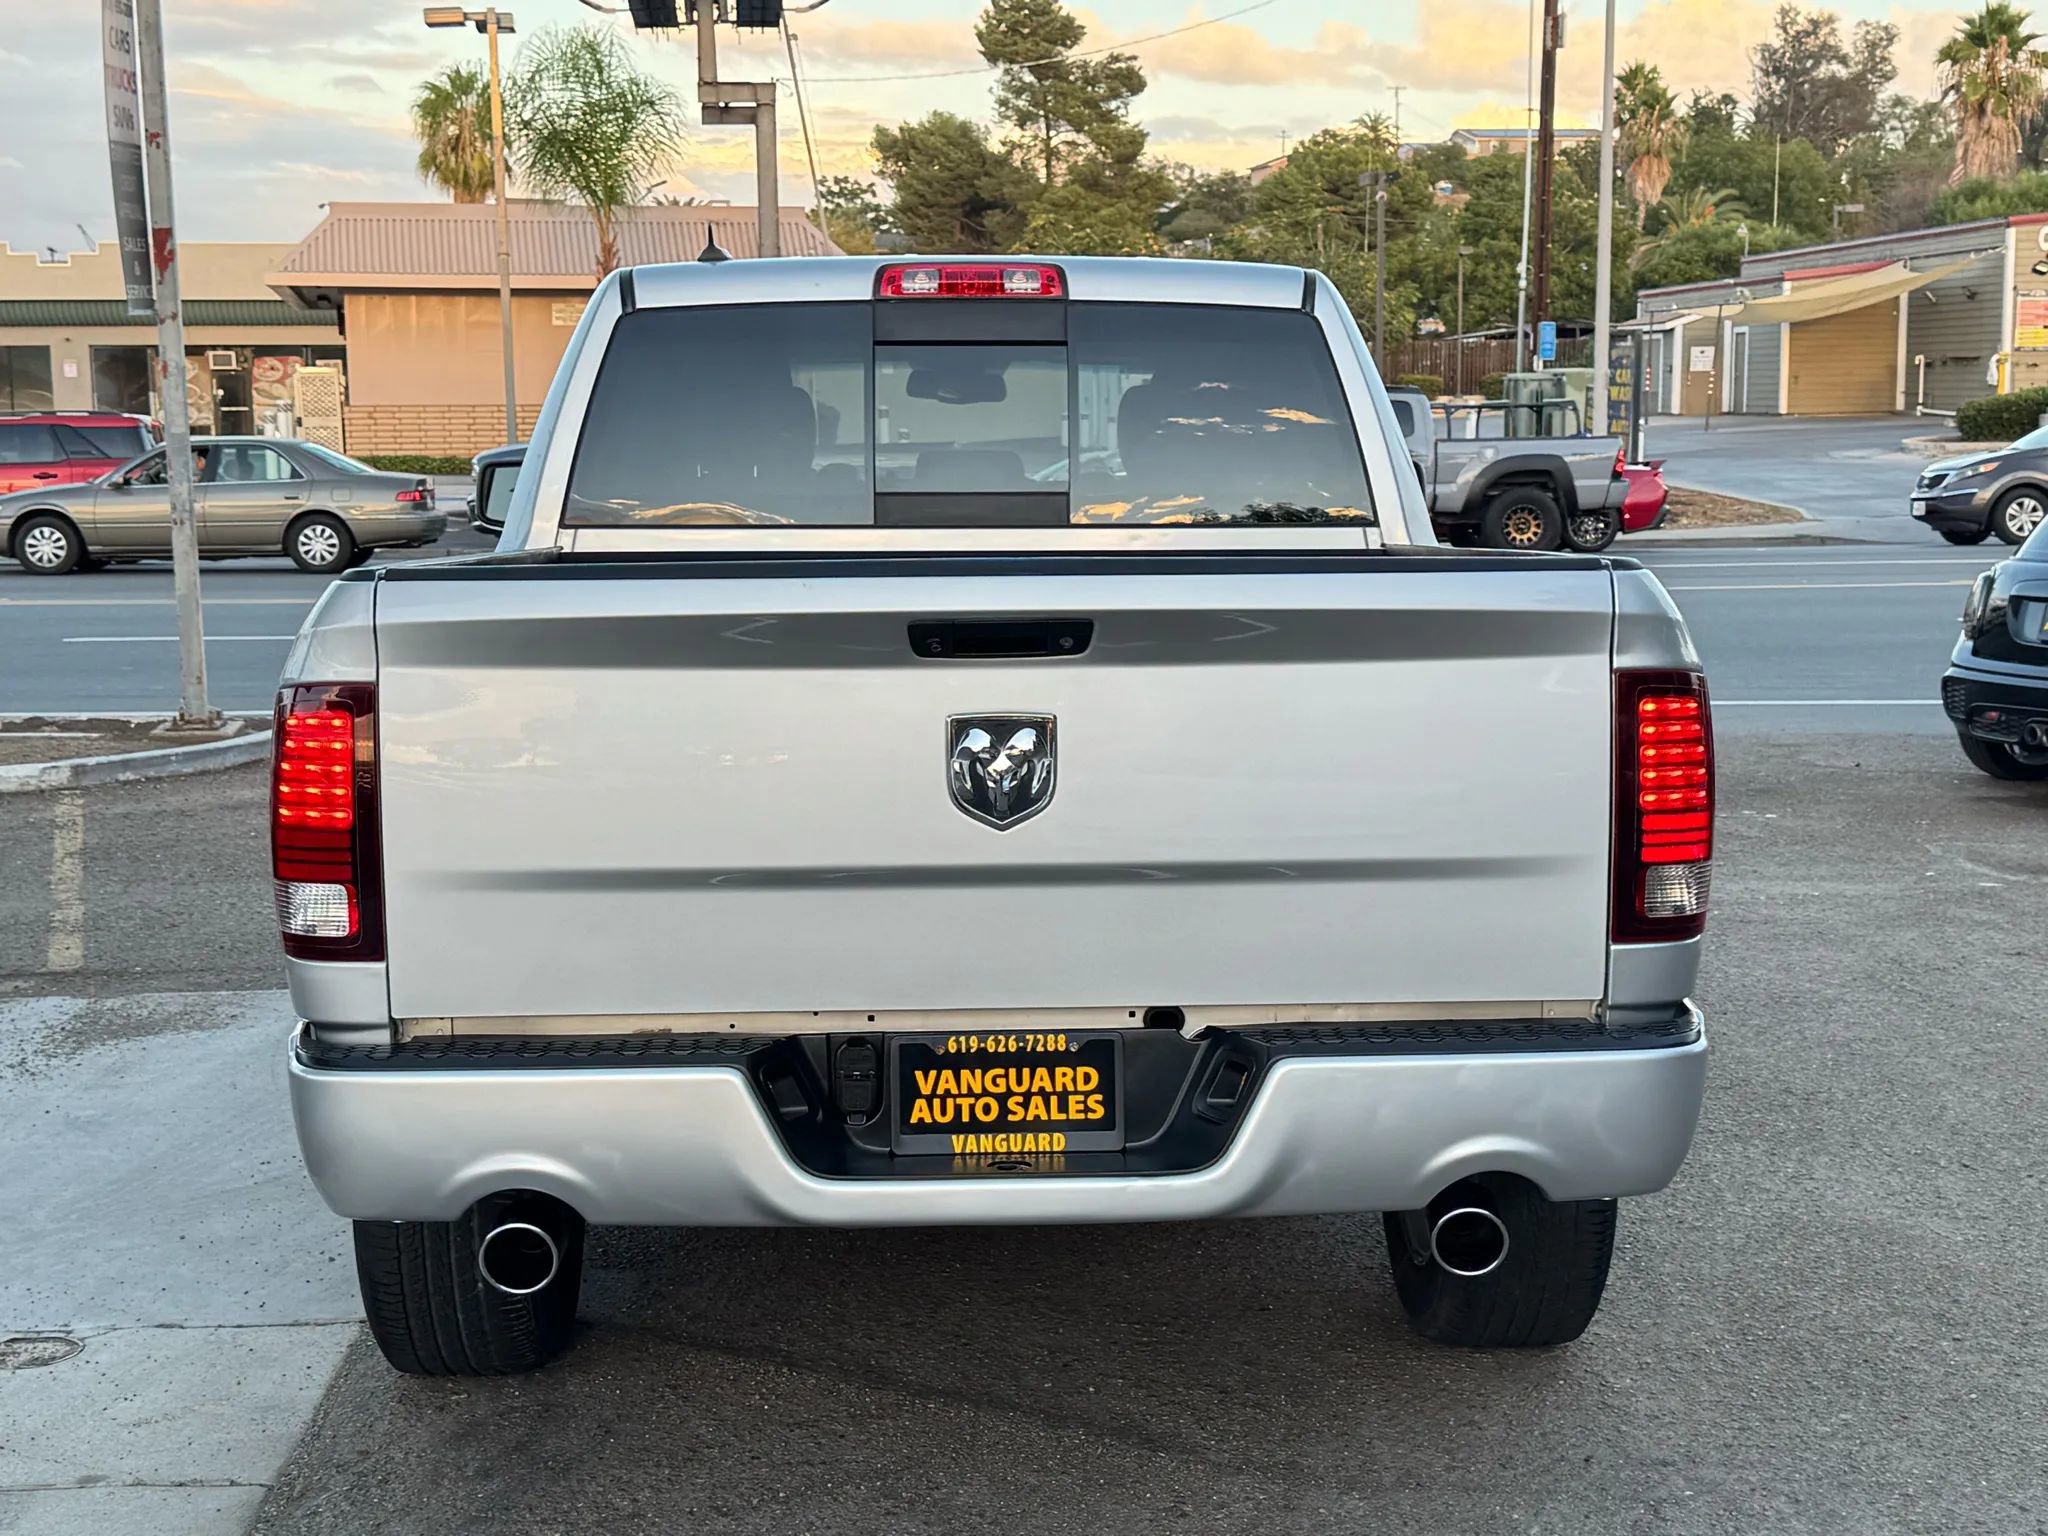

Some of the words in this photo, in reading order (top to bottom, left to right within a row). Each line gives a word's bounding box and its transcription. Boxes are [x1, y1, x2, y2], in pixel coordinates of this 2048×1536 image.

[109, 25, 131, 54] CARS
[123, 236, 147, 251] SALES
[947, 1034, 1067, 1054] 619-626-7288
[914, 1066, 1099, 1095] VANGUARD
[910, 1096, 999, 1123] AUTO
[1007, 1094, 1105, 1121] SALES
[951, 1132, 1066, 1154] VANGUARD
